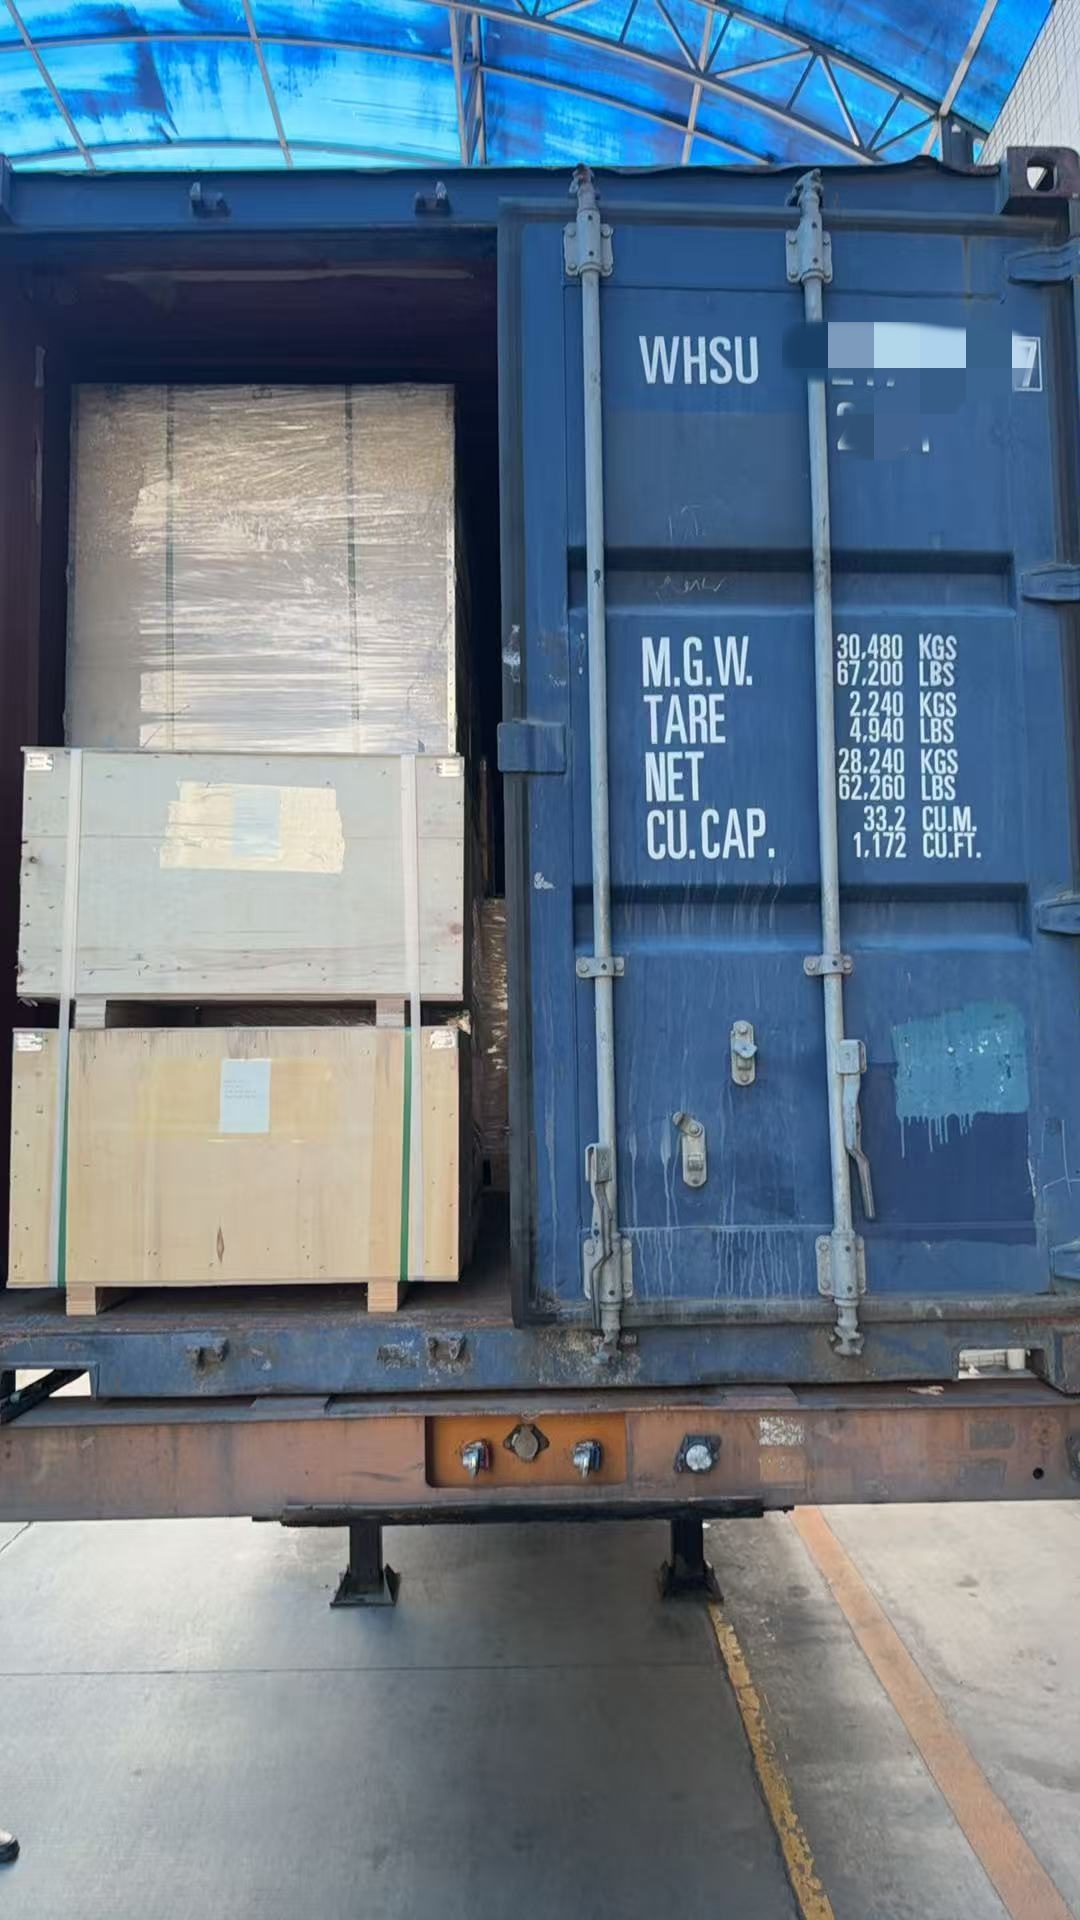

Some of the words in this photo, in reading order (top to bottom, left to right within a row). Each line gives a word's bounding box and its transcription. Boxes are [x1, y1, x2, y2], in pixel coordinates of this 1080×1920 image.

[638, 335, 759, 385] WHSU
[1017, 339, 1038, 388] 7
[836, 633, 903, 661] 30,480
[918, 633, 957, 661] KGS
[641, 635, 753, 688] M.G.W.
[836, 659, 903, 687] 67,200
[919, 660, 955, 687] LBS
[849, 690, 904, 718] 2,240
[919, 691, 957, 718] KGS
[643, 693, 726, 745] TARE
[849, 716, 904, 744] 4,940
[920, 717, 954, 744] LBS
[838, 747, 905, 775] 28,240
[920, 748, 959, 775] KGS
[644, 750, 705, 803] NET
[838, 774, 905, 801] 62,260
[921, 774, 956, 801] LBS
[863, 805, 907, 832] 33.2
[922, 805, 978, 832] CU.M.
[646, 807, 775, 860] CU.CAP.
[853, 831, 907, 859] 1,172
[922, 831, 982, 859] CU.FT.
